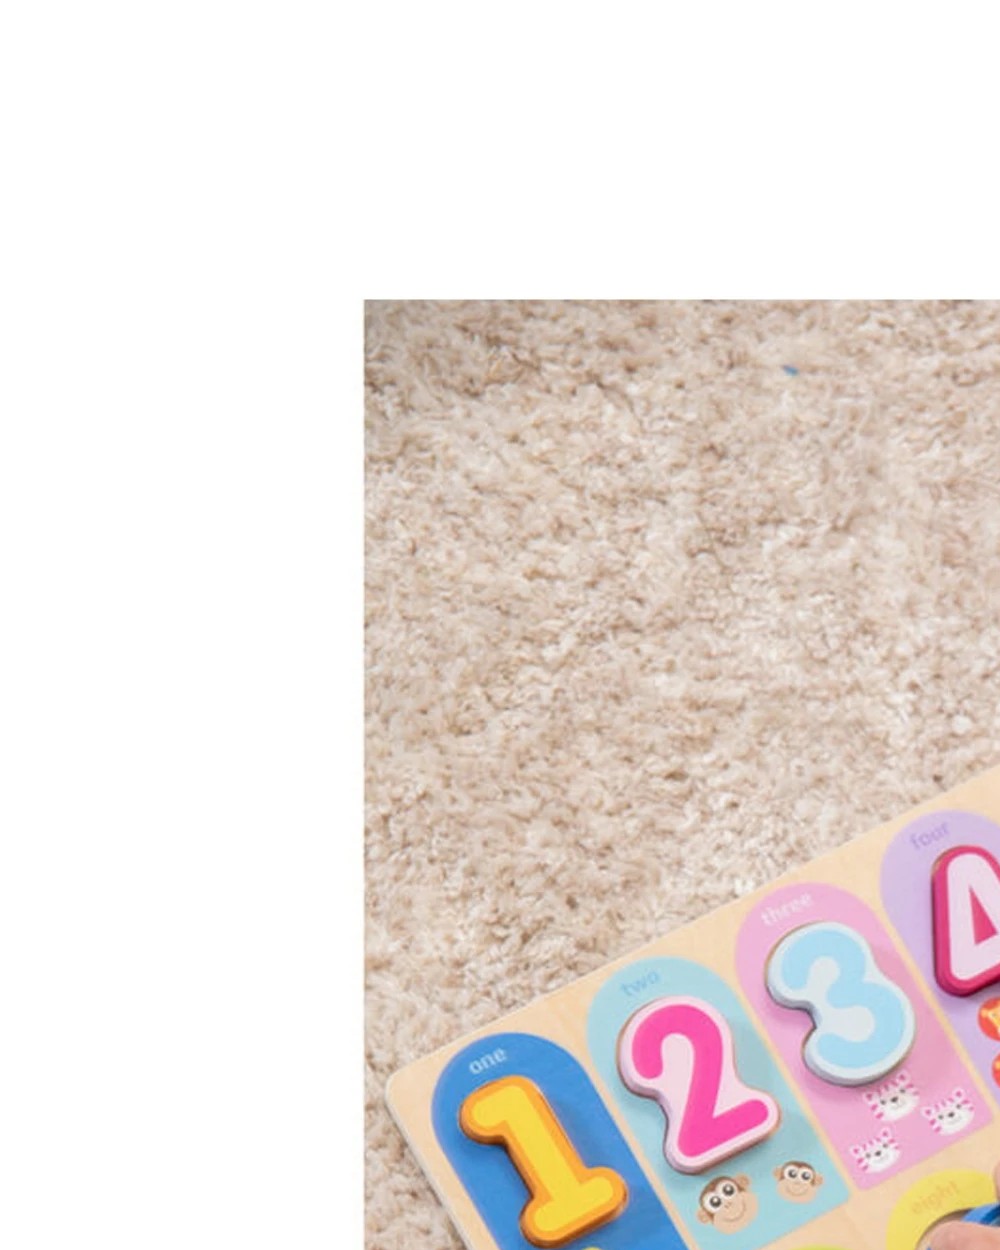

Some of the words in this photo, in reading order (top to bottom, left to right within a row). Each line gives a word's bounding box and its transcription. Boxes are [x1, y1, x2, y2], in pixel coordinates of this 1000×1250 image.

[910, 820, 951, 850] four
[761, 892, 812, 926] three
[621, 970, 660, 998] two
[774, 926, 908, 1075] 3
[468, 1047, 506, 1075] one
[626, 1000, 772, 1164] 2
[463, 1080, 624, 1242] 1
[911, 1180, 959, 1217] eight
